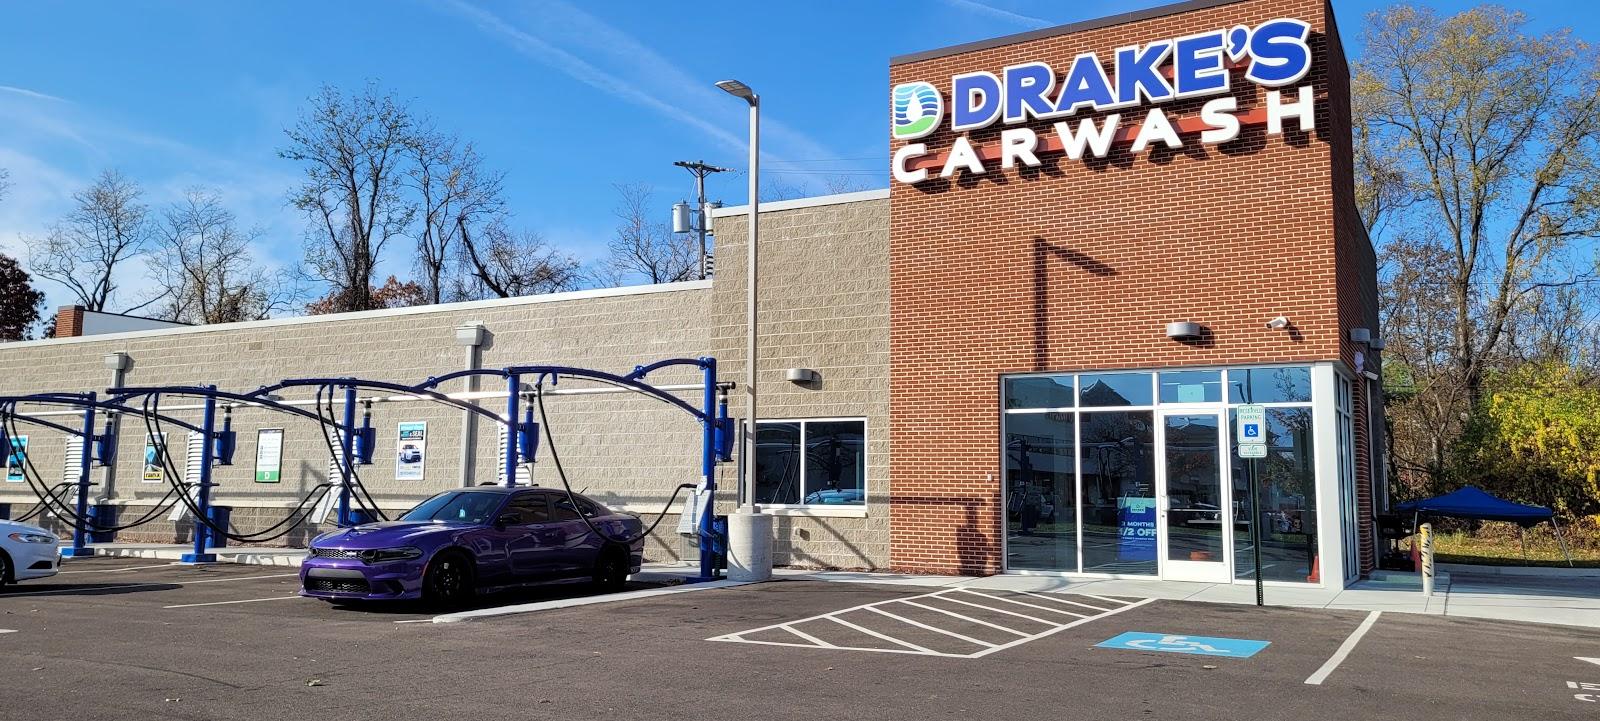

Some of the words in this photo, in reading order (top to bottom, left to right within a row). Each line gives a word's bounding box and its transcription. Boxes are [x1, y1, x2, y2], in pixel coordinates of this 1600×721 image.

[951, 18, 1311, 132] DRAKE'S
[892, 86, 1315, 184] CARWASH
[1137, 528, 1156, 536] OFF
